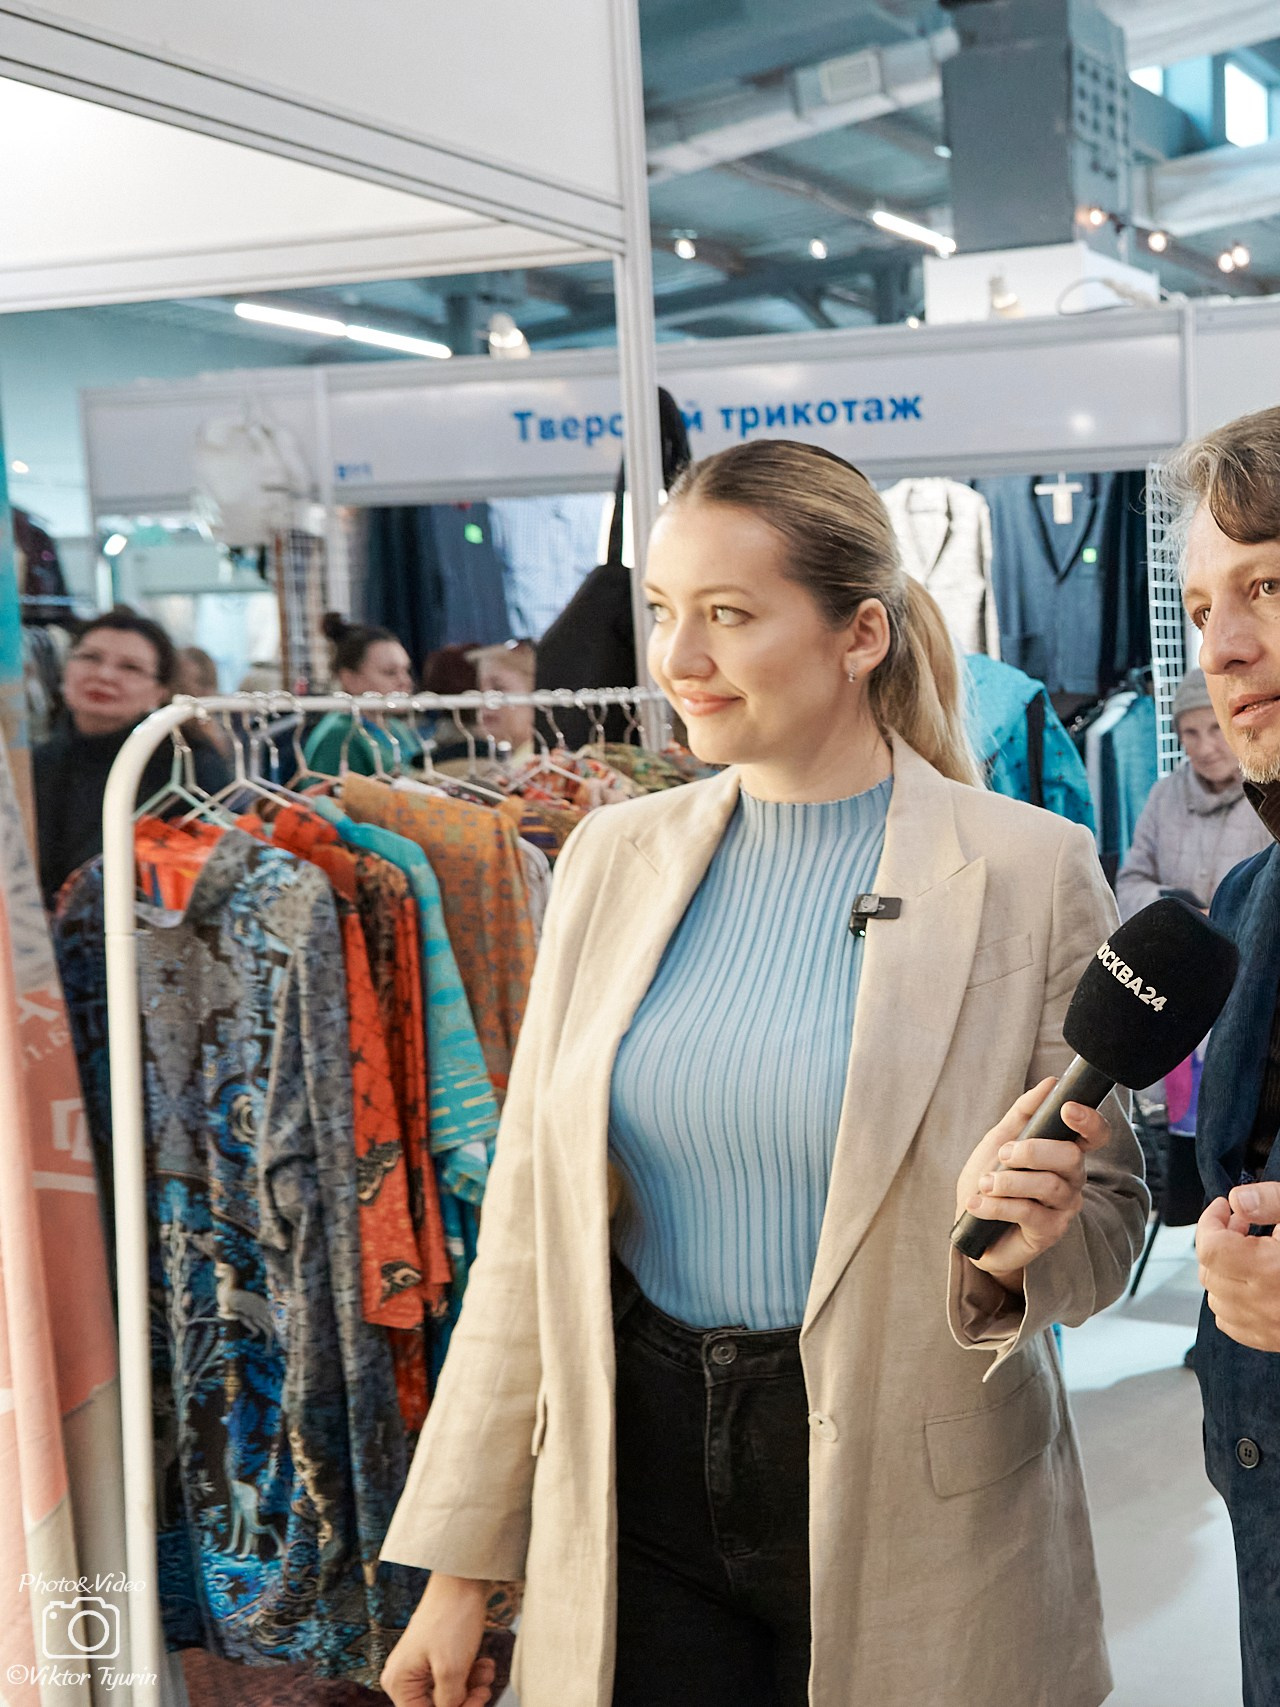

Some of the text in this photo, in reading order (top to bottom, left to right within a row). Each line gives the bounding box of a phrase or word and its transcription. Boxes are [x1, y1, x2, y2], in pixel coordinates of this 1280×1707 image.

[513, 394, 922, 446] Тверсй трикотаж
[1096, 940, 1168, 1012] ОСКВА24
